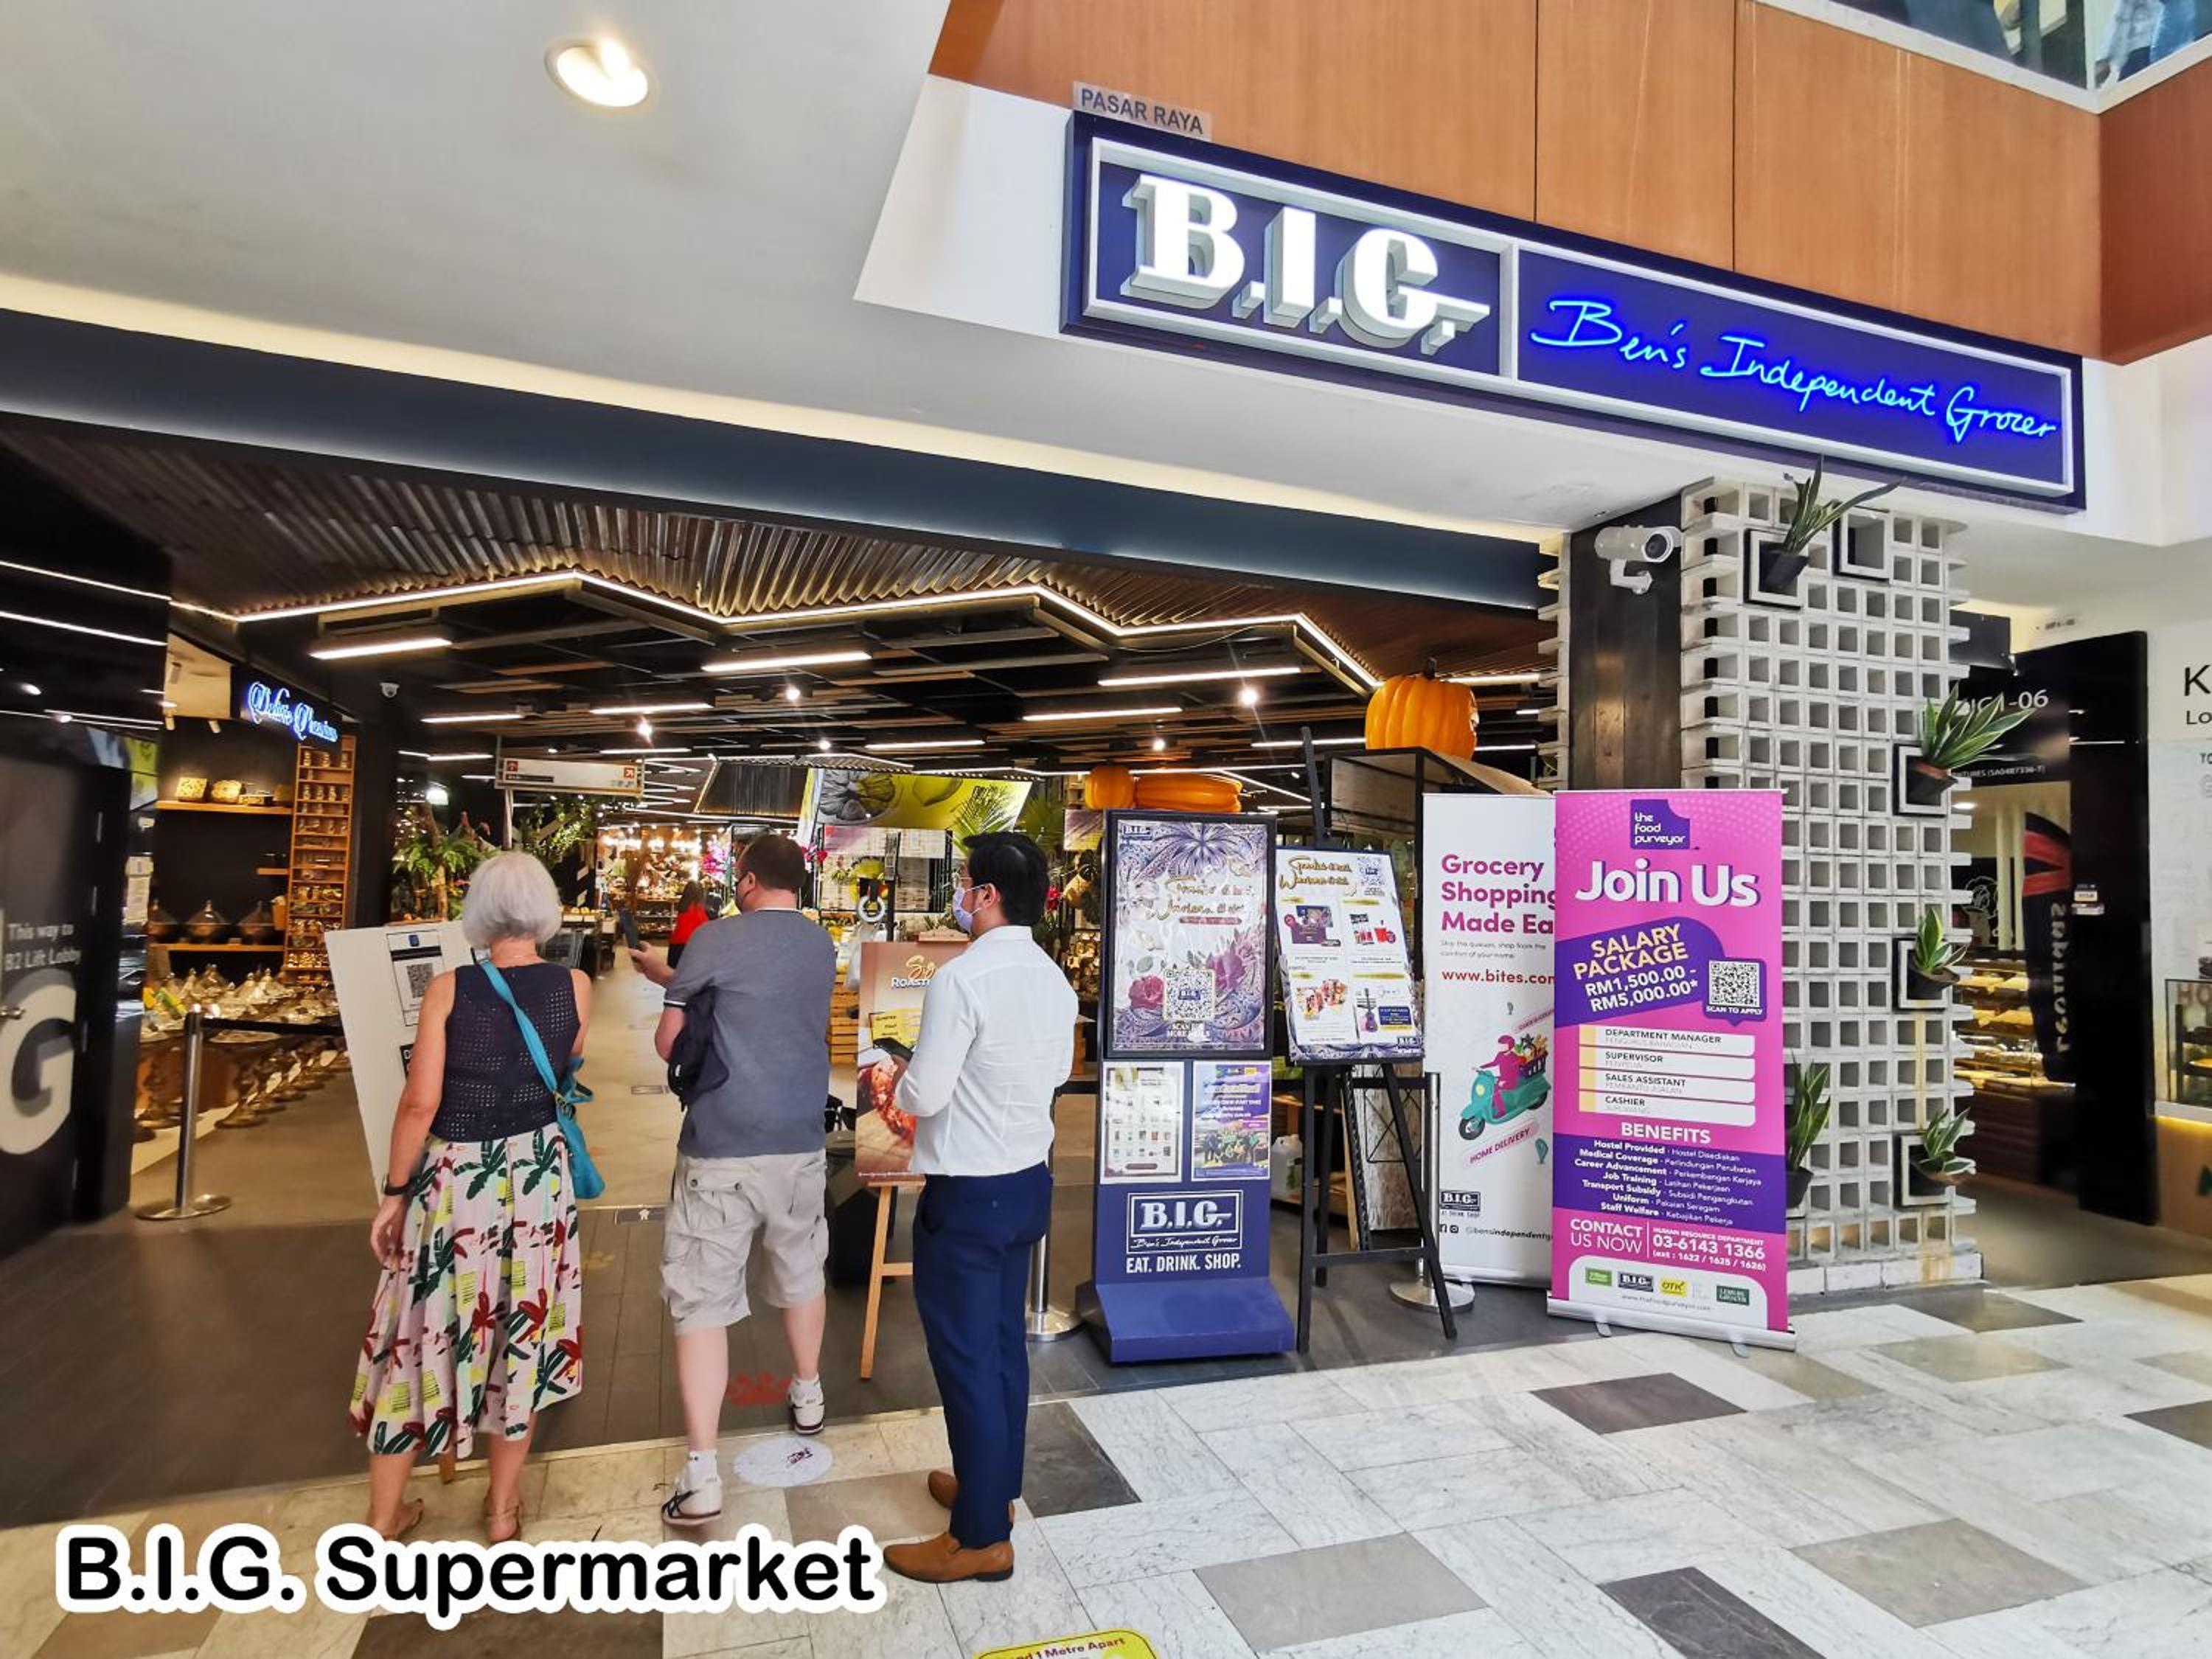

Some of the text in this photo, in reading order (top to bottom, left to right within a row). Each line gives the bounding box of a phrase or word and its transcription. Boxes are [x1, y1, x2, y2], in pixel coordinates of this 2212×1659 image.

[1081, 88, 1204, 136] PASAR RAYA
[1121, 174, 1490, 355] B.I.G.
[1531, 300, 2056, 443] Ben's Independent Grocer
[1635, 812, 1654, 822] the
[1635, 823, 1661, 835] food
[1635, 835, 1686, 846] purveyor
[1441, 854, 1545, 882] Grocery
[1575, 858, 1761, 908] Join Us
[1441, 911, 1554, 934] Made Ea
[1590, 922, 1680, 958] SALARY
[1573, 942, 1688, 980] PACKAGE
[1585, 966, 1685, 996] RM1,500.00
[1740, 1007, 1763, 1015] APPLY
[1605, 1029, 1722, 1043] DEPARTMENT MANAGER
[1605, 1051, 1663, 1062] SUPERVISOR
[1605, 1074, 1686, 1088] SALES ASSISTANT
[1605, 1096, 1645, 1106] CASHIER
[1621, 1122, 1711, 1144] BENEFITS
[1470, 1127, 1530, 1164] HOME DELIVERY
[1593, 1140, 1622, 1150] Hostel
[1624, 1143, 1665, 1154] Provided
[1672, 1148, 1696, 1158] Hostel
[1574, 1158, 1604, 1169] Career
[1605, 1161, 1666, 1175] Advancement
[1579, 1148, 1613, 1160] Medical
[1615, 1152, 1658, 1165] Coverage
[1602, 1172, 1621, 1181] Job
[1621, 1173, 1657, 1186] Training
[1582, 1179, 1624, 1192] Transport
[1626, 1183, 1661, 1196] Subsidy
[1669, 1189, 1696, 1200] Subsidi
[1601, 1201, 1623, 1212] Staff
[1624, 1204, 1659, 1217] Welfare
[1613, 1193, 1649, 1205] Uniform
[1686, 1202, 1720, 1214] Seragam
[1140, 1200, 1232, 1231] B.I.G.
[1570, 1218, 1643, 1238] CONTACT
[1681, 1230, 1716, 1240] RESOURCE
[1717, 1234, 1764, 1246] DEPARTMENT
[1571, 1232, 1643, 1254] US NOW
[1652, 1234, 1765, 1260] 03-6143 1366
[1126, 1253, 1241, 1273] EAT. DRINK. SHOP.
[1678, 1253, 1700, 1263] 1622
[1045, 1646, 1085, 1659] Metre
[1088, 1638, 1126, 1651] Apart
